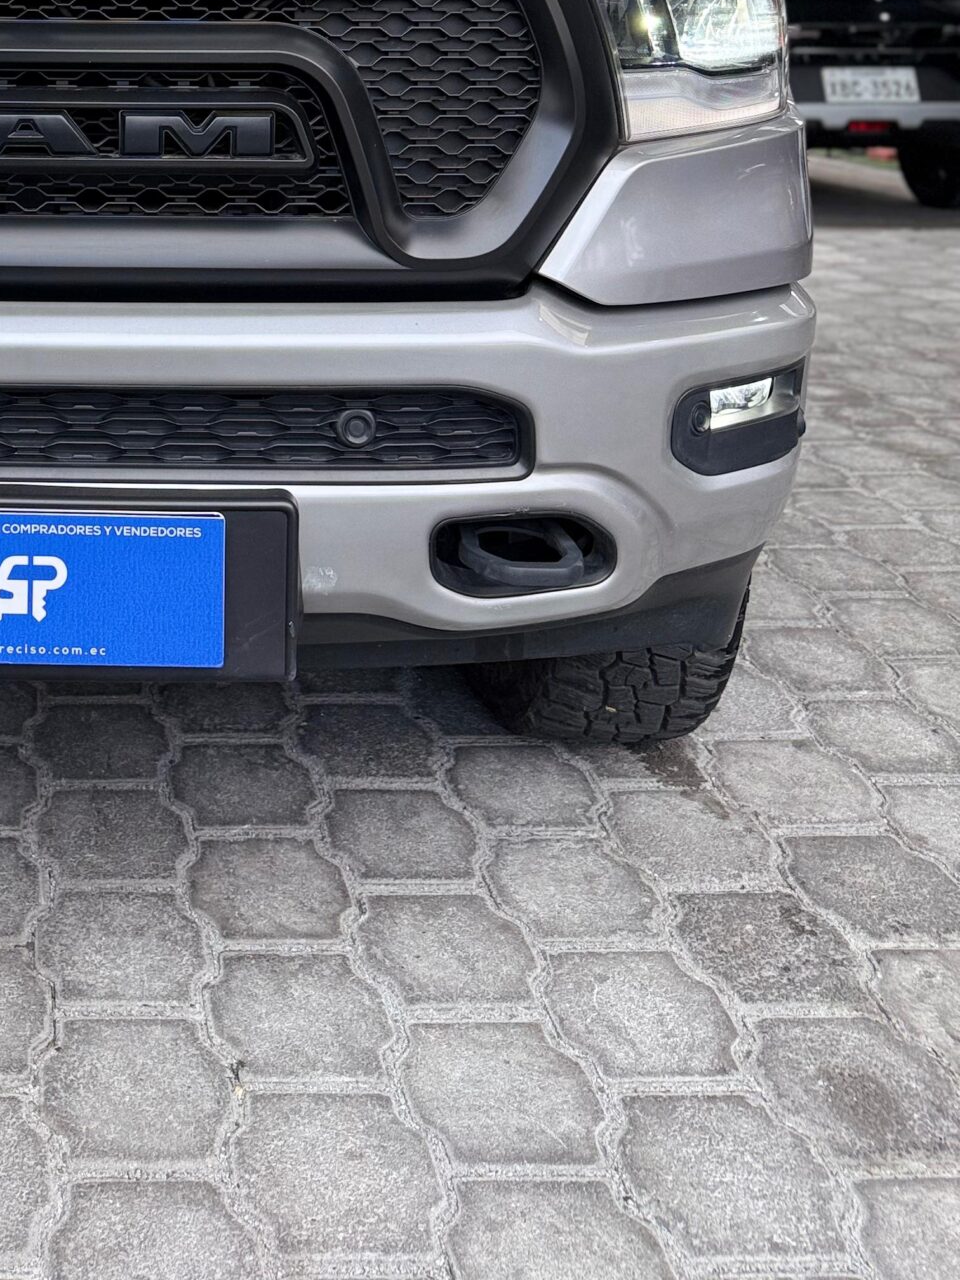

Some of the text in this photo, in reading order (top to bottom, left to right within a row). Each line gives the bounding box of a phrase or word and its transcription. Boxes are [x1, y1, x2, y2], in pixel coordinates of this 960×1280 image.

[1, 523, 101, 536] COMPRADORES
[103, 525, 113, 536] Y
[114, 526, 202, 538] VENDEDORES
